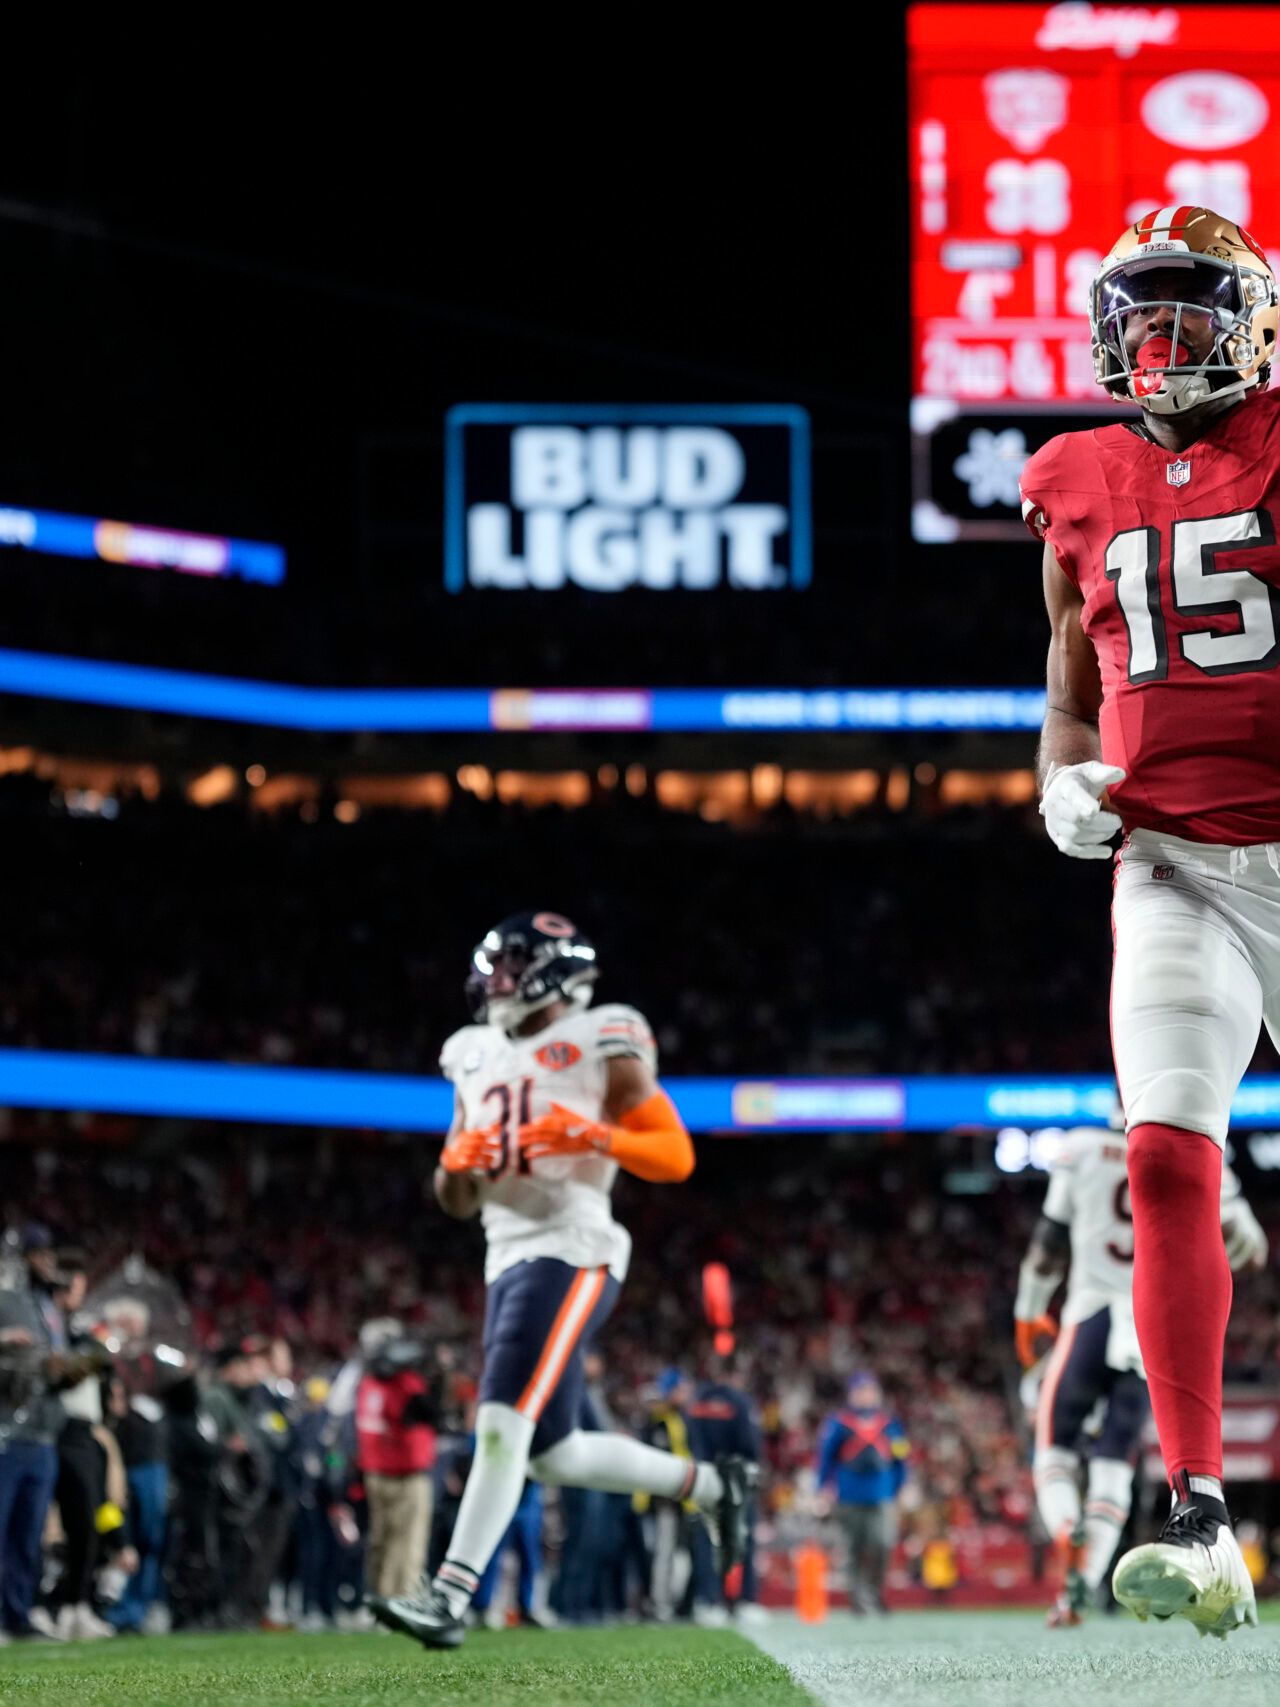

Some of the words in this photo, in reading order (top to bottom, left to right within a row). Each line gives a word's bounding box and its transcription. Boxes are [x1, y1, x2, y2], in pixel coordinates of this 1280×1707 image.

[511, 425, 745, 510] BUD
[1171, 471, 1187, 482] NFL
[467, 503, 788, 591] LIGHT
[482, 1077, 536, 1183] 31
